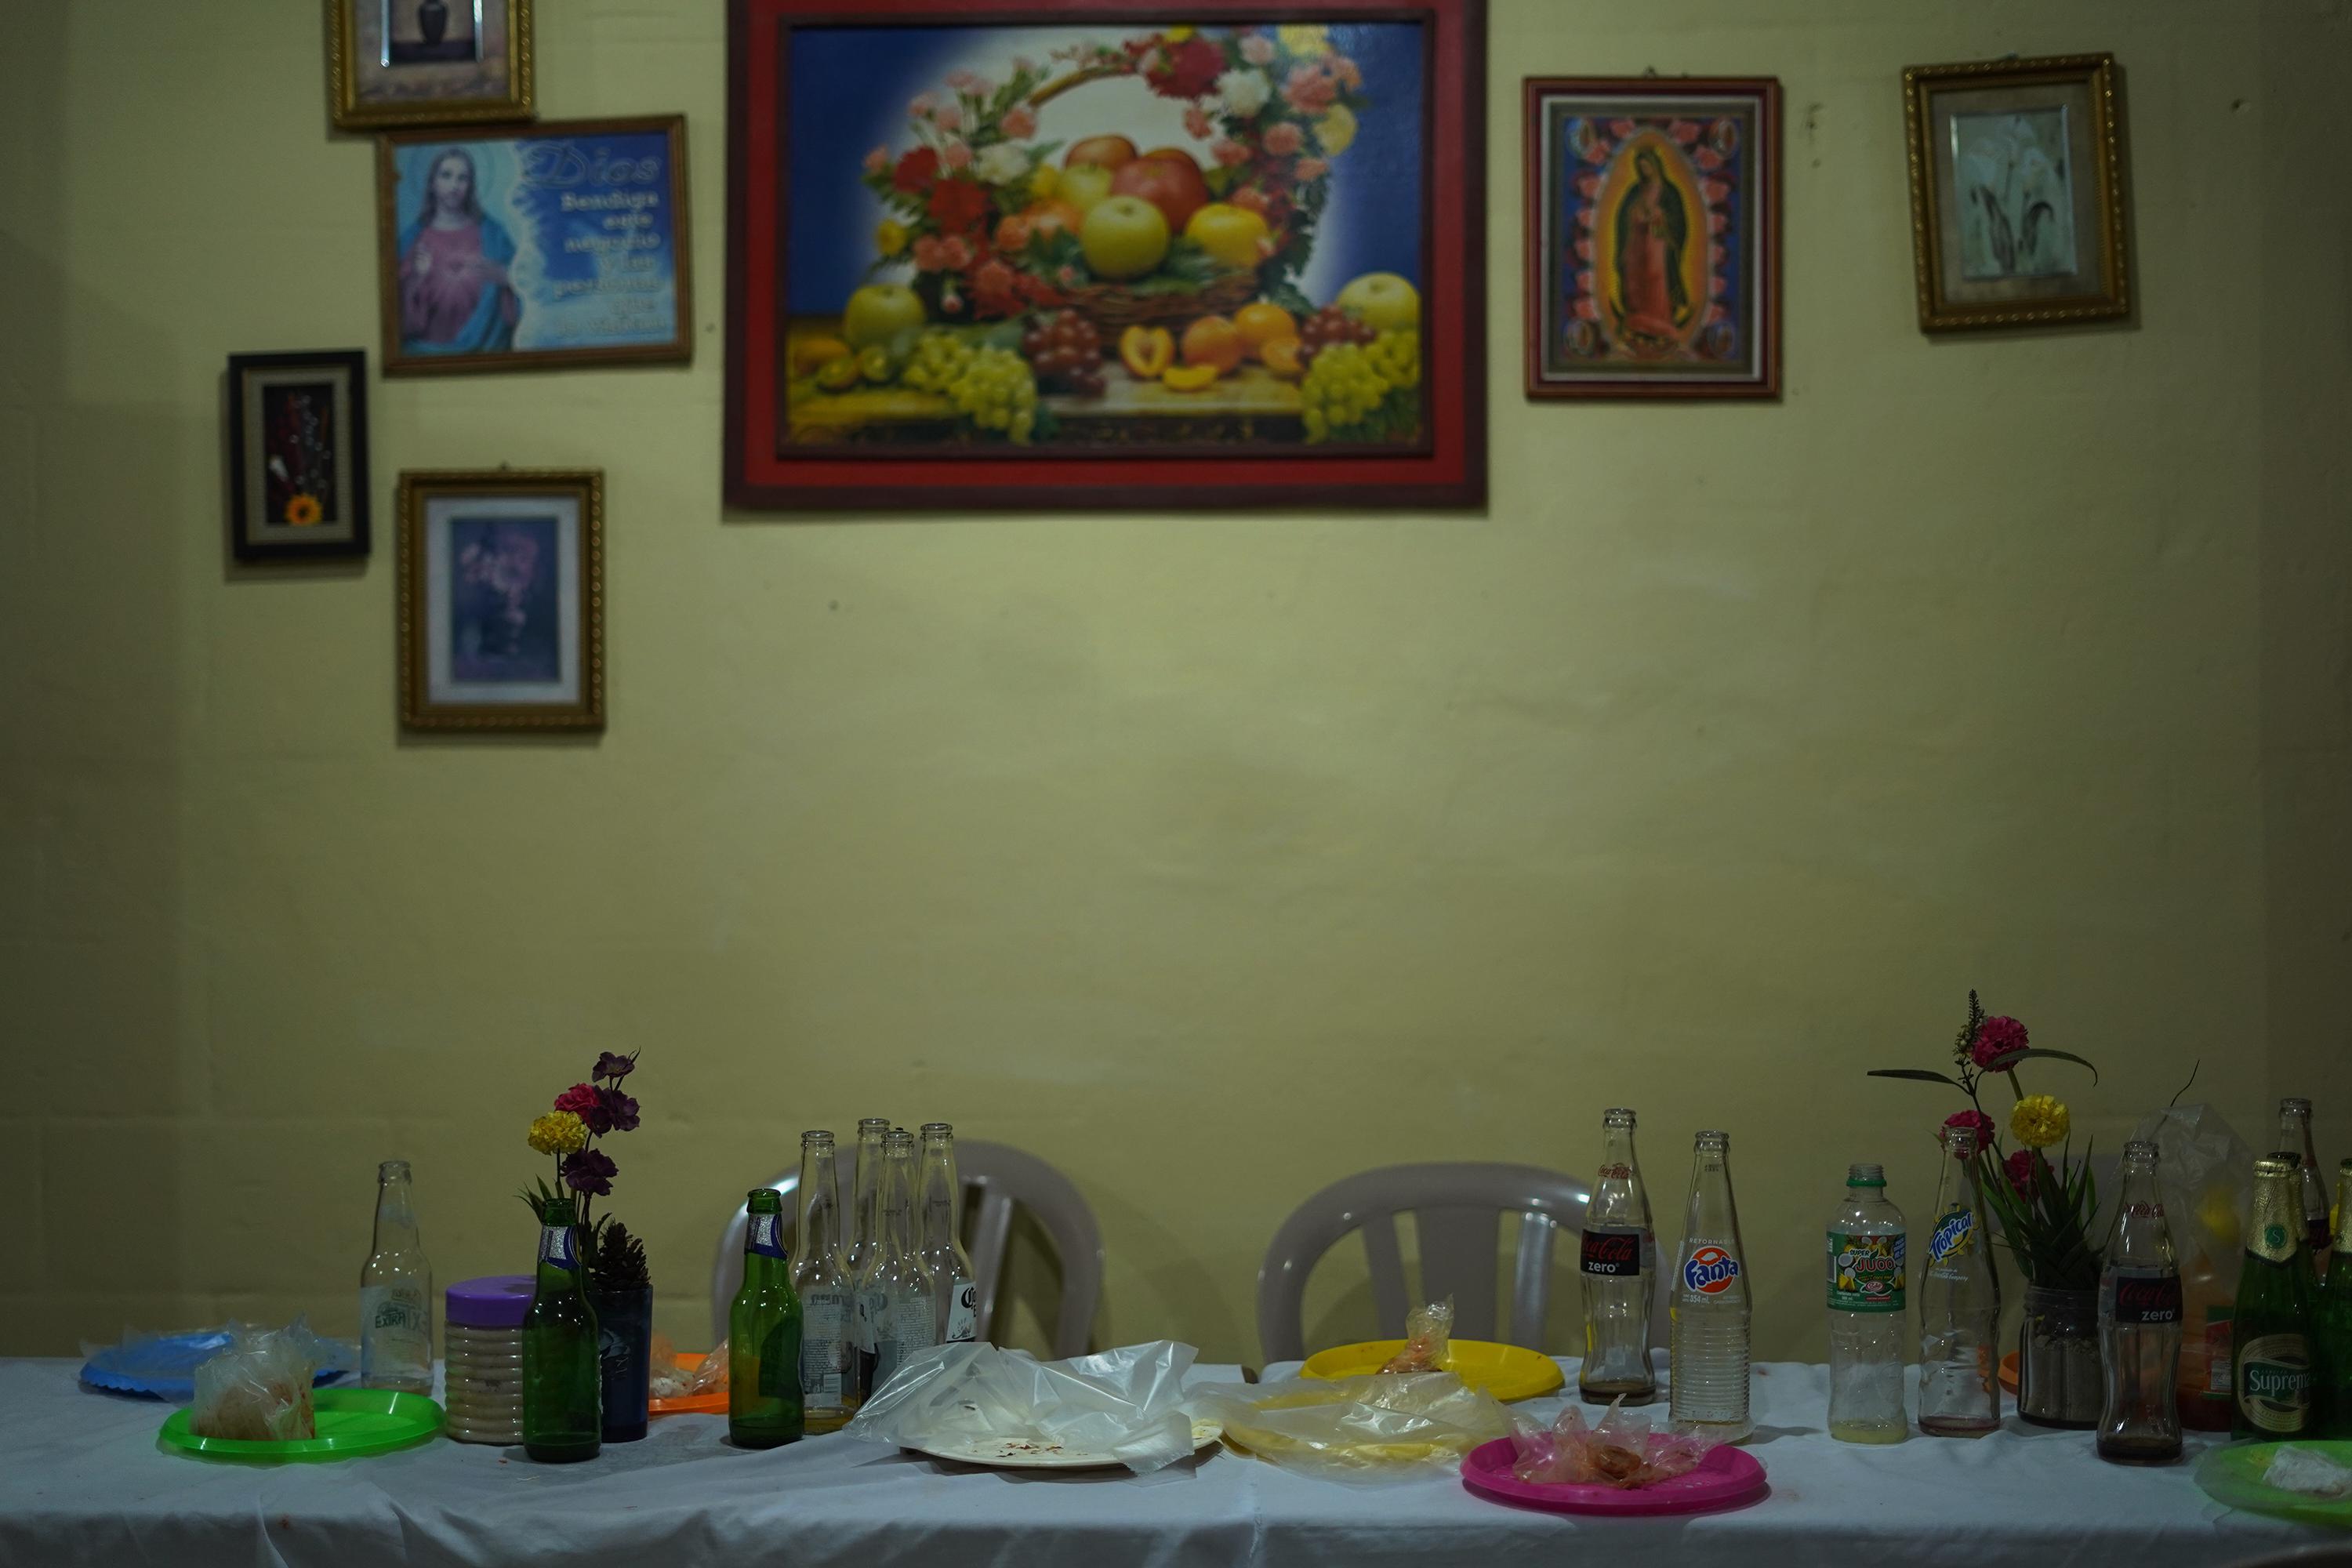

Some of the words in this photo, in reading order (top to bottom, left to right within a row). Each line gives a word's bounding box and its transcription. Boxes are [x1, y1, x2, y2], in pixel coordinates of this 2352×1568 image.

[521, 140, 662, 188] Dios
[1929, 1212, 1973, 1261] Tropical
[1588, 1261, 1617, 1274] zero
[1684, 1255, 1739, 1290] Fanta
[1689, 1294, 1700, 1304] 354
[2119, 1279, 2179, 1306] Coca-Co
[2140, 1310, 2172, 1321] zero
[2249, 1369, 2310, 1397] Suprem
